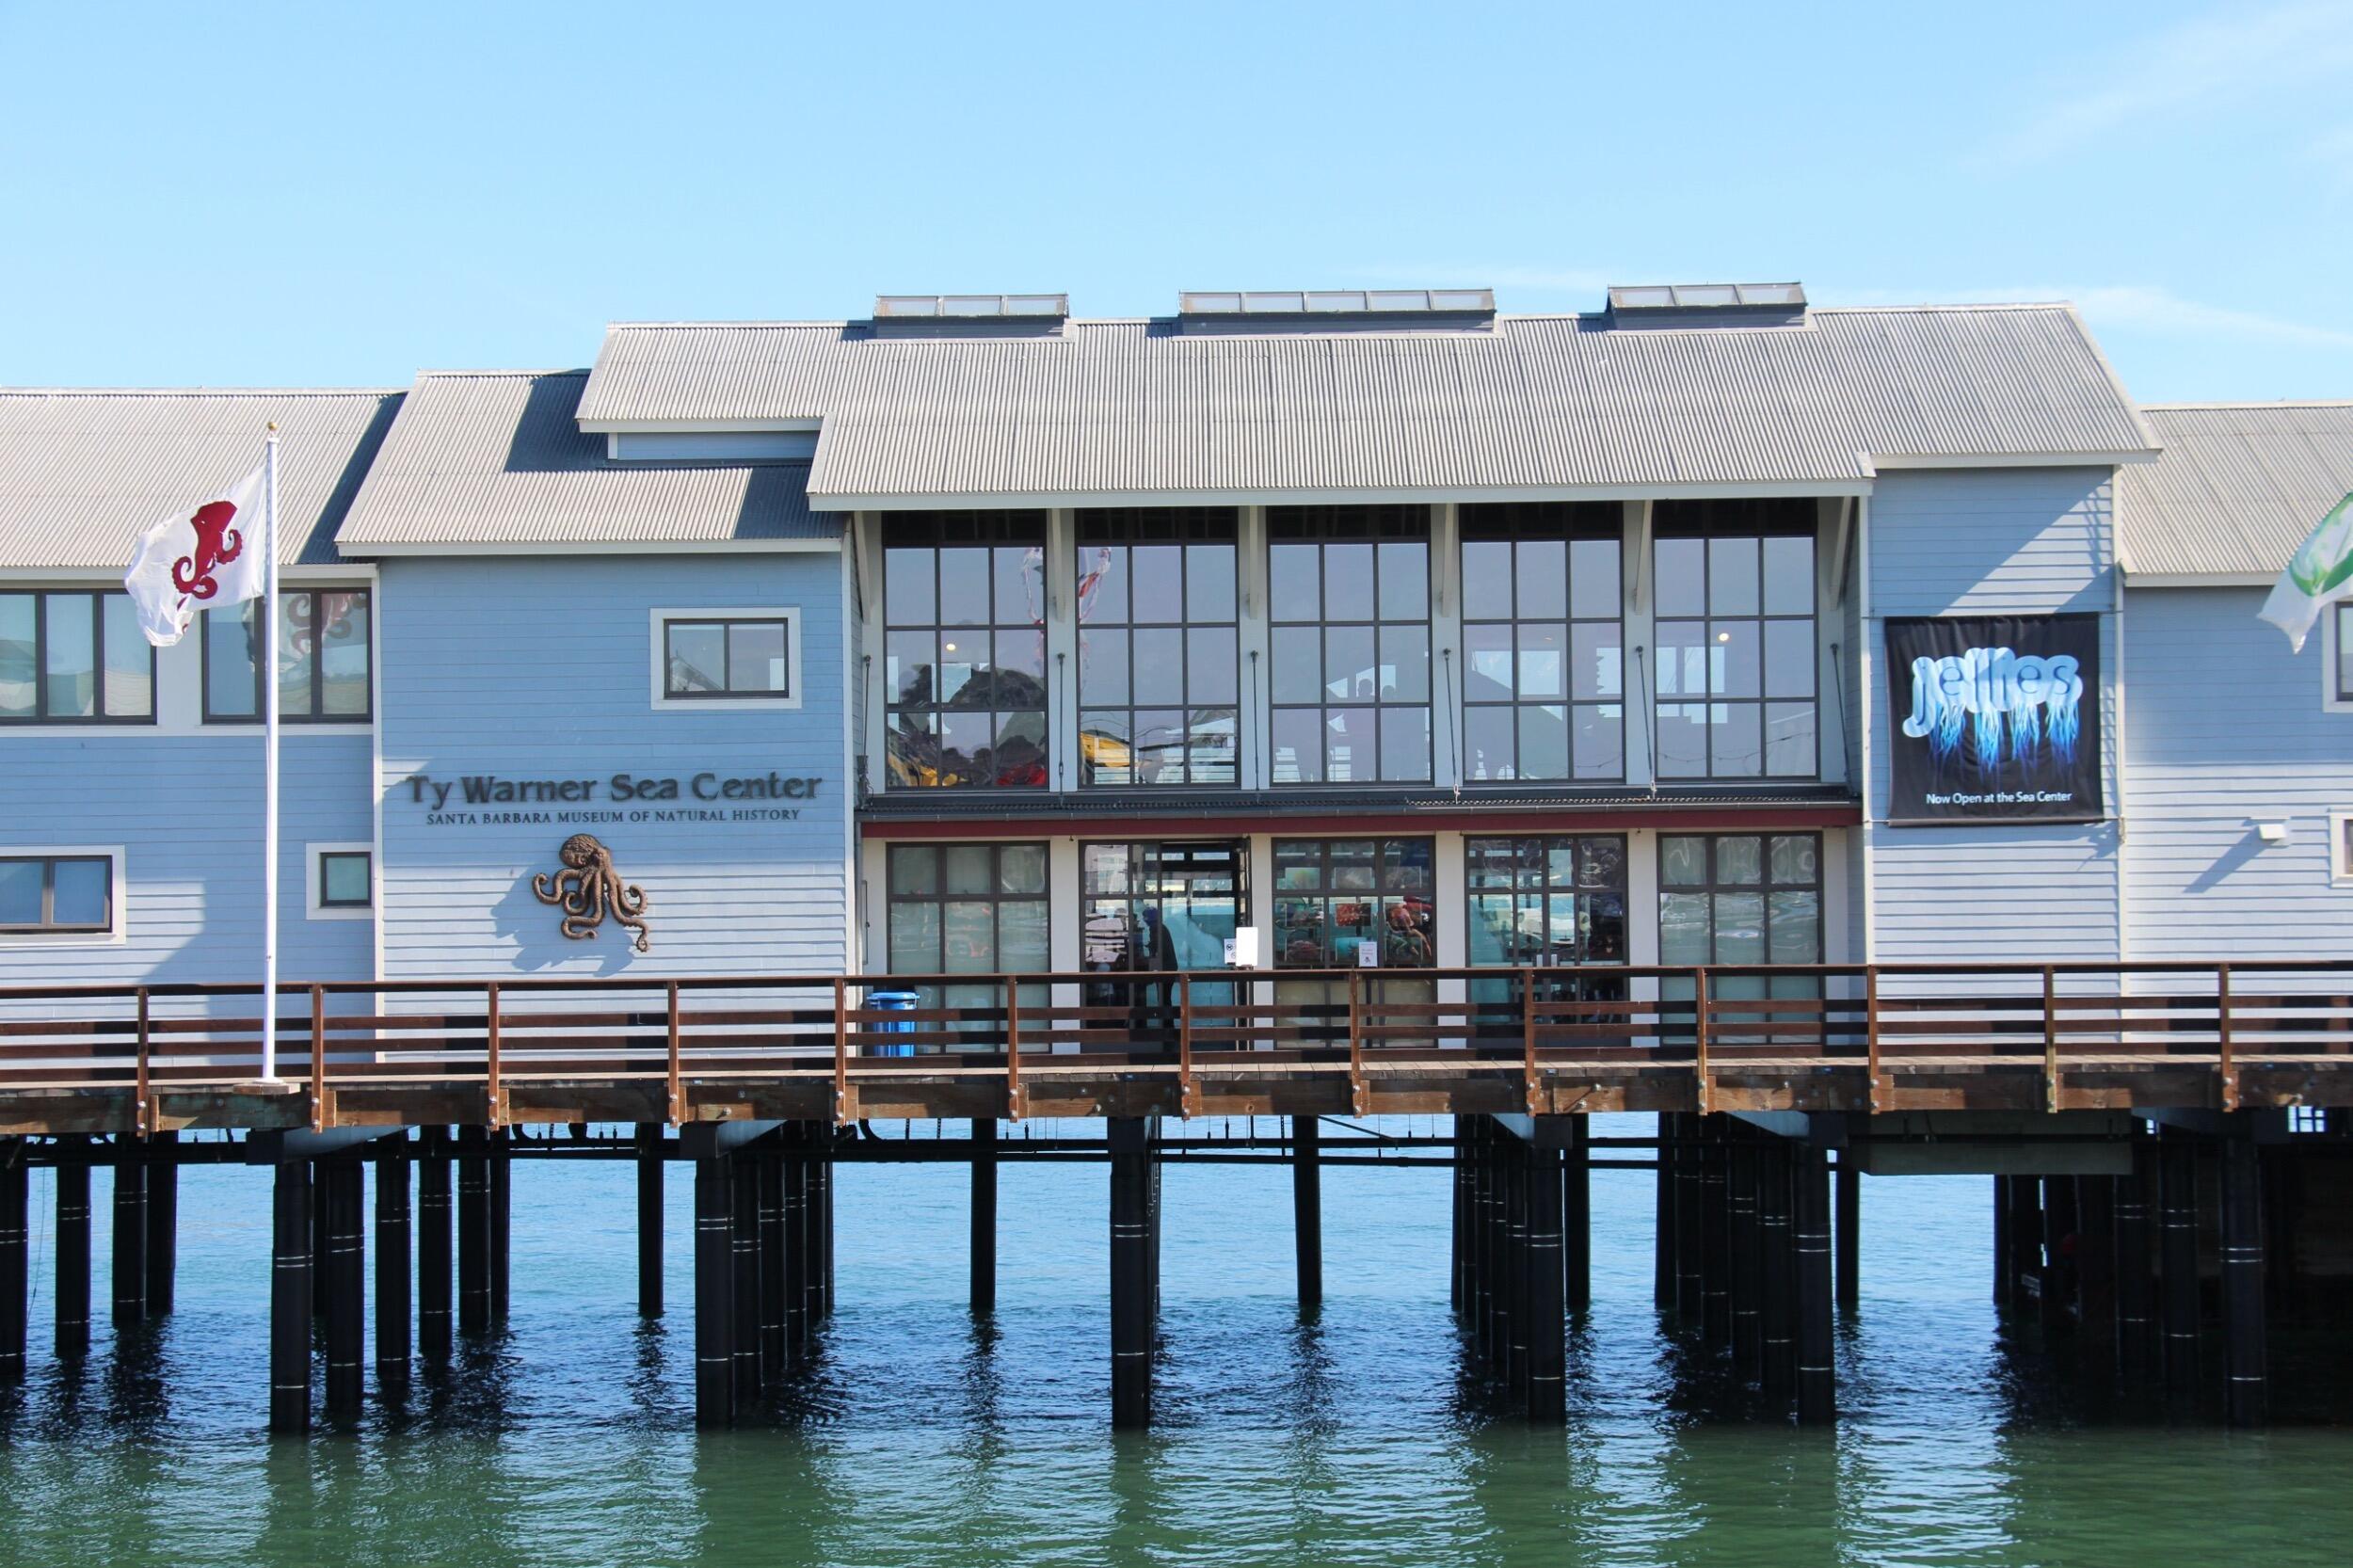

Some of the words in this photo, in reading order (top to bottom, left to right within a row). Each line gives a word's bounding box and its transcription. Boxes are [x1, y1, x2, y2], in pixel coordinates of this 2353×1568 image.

[1902, 647, 2083, 738] jellies
[406, 776, 453, 810] Ty
[460, 776, 598, 804] Warner
[611, 774, 679, 801] Sea
[692, 771, 823, 801] Center
[1926, 793, 1951, 805] Now
[1952, 792, 1982, 807] Open
[1983, 793, 1994, 803] at
[1996, 792, 2015, 803] the
[2015, 791, 2035, 803] Sea
[2037, 791, 2073, 802] Center
[426, 812, 476, 825] SANTA
[483, 812, 551, 824] BARBARA
[557, 811, 624, 824] MUSEUM
[630, 810, 649, 823] OF
[655, 809, 727, 822] NATURAL
[732, 808, 800, 821] HISTORY
